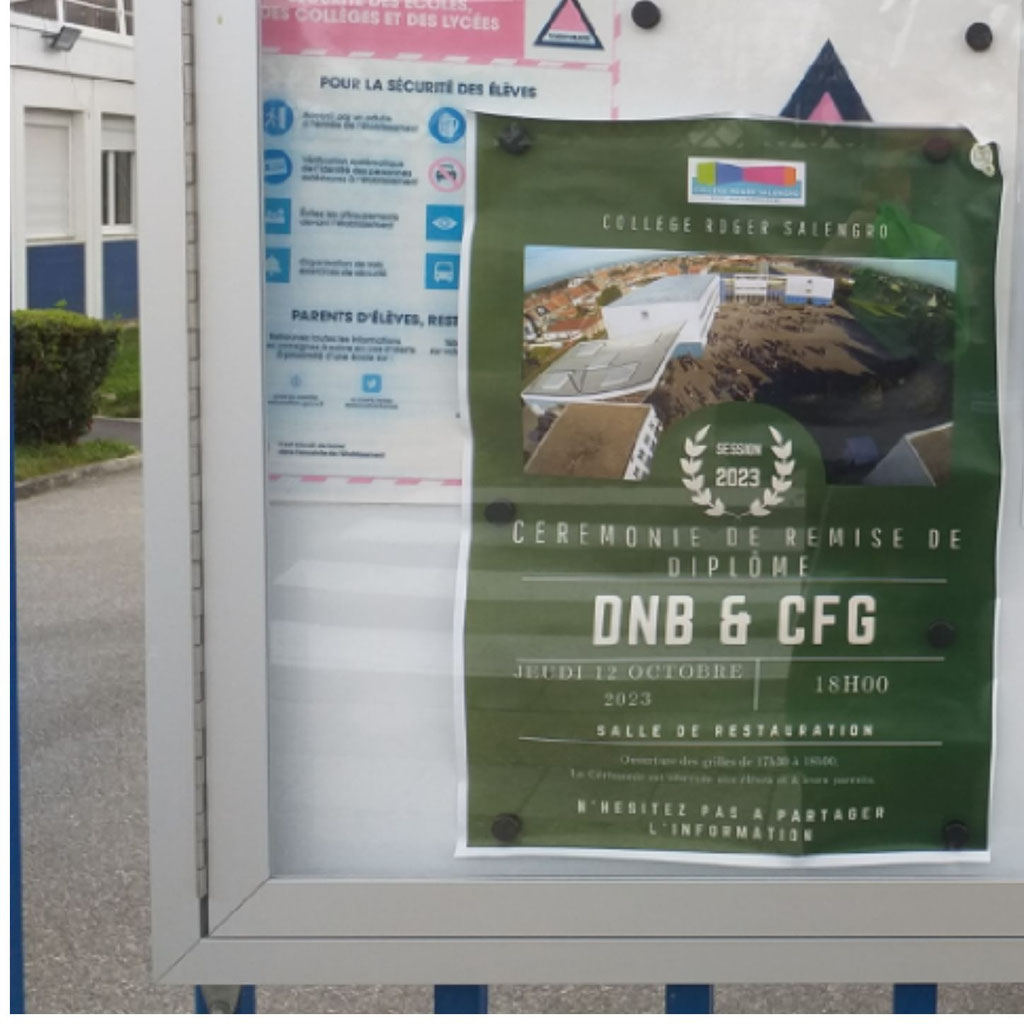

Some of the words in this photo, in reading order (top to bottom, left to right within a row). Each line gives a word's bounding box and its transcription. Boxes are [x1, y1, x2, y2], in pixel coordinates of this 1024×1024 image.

[385, 10, 401, 26] ET
[407, 13, 437, 28] DES
[443, 12, 500, 32] LYCÉES
[320, 75, 360, 90] POUR
[366, 78, 383, 91] LA
[458, 82, 483, 96] DES
[603, 214, 691, 234] COLLEGE
[706, 217, 769, 235] ROGER
[784, 221, 888, 239] SALENGRO
[291, 309, 353, 324] PARENTS
[716, 442, 763, 456] SESSION
[716, 468, 761, 487] 2023
[726, 527, 760, 547] DE
[785, 527, 904, 549] REMISE
[928, 528, 961, 550] DE
[668, 550, 808, 578] DIPLÔME
[592, 594, 694, 646] DNB
[720, 594, 751, 646] &
[778, 594, 876, 646] CFG
[512, 664, 582, 681] JEUDI
[595, 664, 618, 680] 12
[628, 663, 743, 680] OCTOBRE
[815, 676, 889, 694] 18H00
[604, 691, 652, 707] 2023
[596, 724, 662, 738] SALLE
[677, 724, 699, 738] DE
[715, 724, 874, 738] RESTAURATION
[578, 798, 686, 817] N'HESITEZ
[701, 805, 738, 820] PAS
[753, 807, 763, 821] A
[778, 806, 885, 823] PARTAGER
[650, 822, 813, 842] L'INFORMATION
